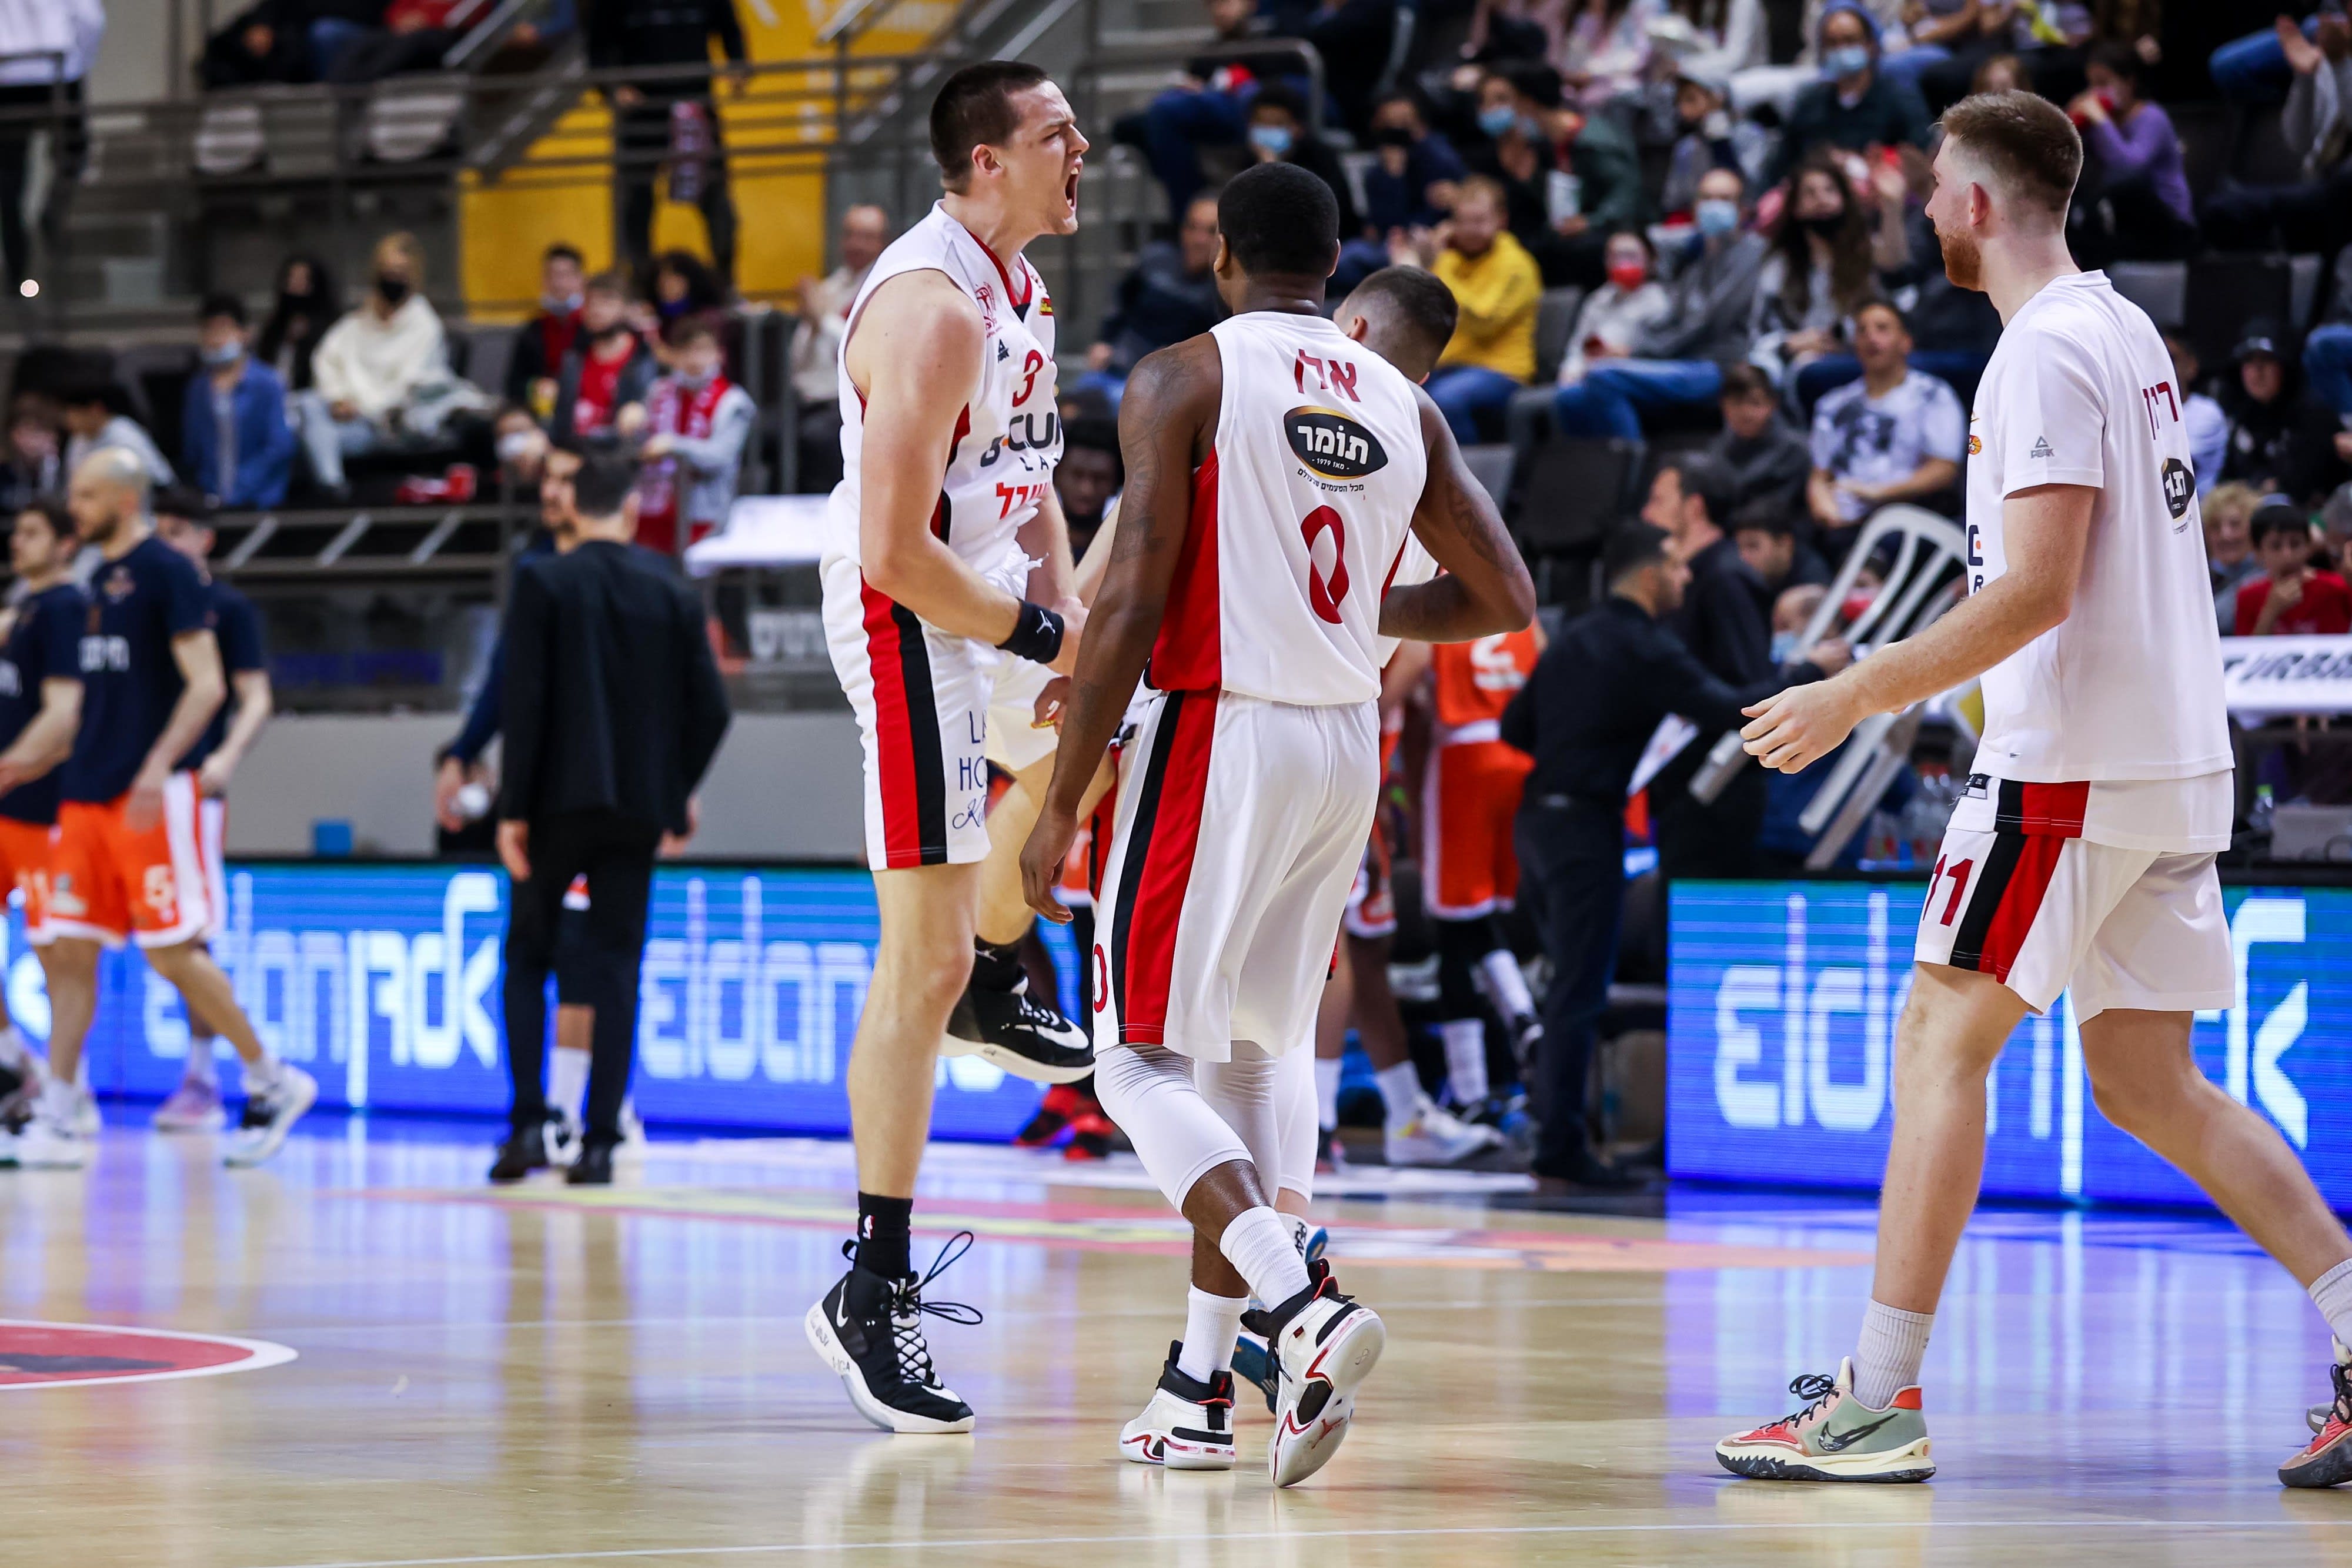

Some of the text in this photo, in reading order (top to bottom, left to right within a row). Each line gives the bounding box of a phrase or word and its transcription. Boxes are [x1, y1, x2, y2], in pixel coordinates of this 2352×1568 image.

[1013, 349, 1043, 407] 3
[1317, 457, 1331, 466] 1979
[2030, 447, 2054, 459] PEAK
[1349, 484, 1364, 492] מכל
[1300, 504, 1350, 624] 0
[1923, 854, 1975, 927] 11
[1092, 943, 1108, 1013] 0
